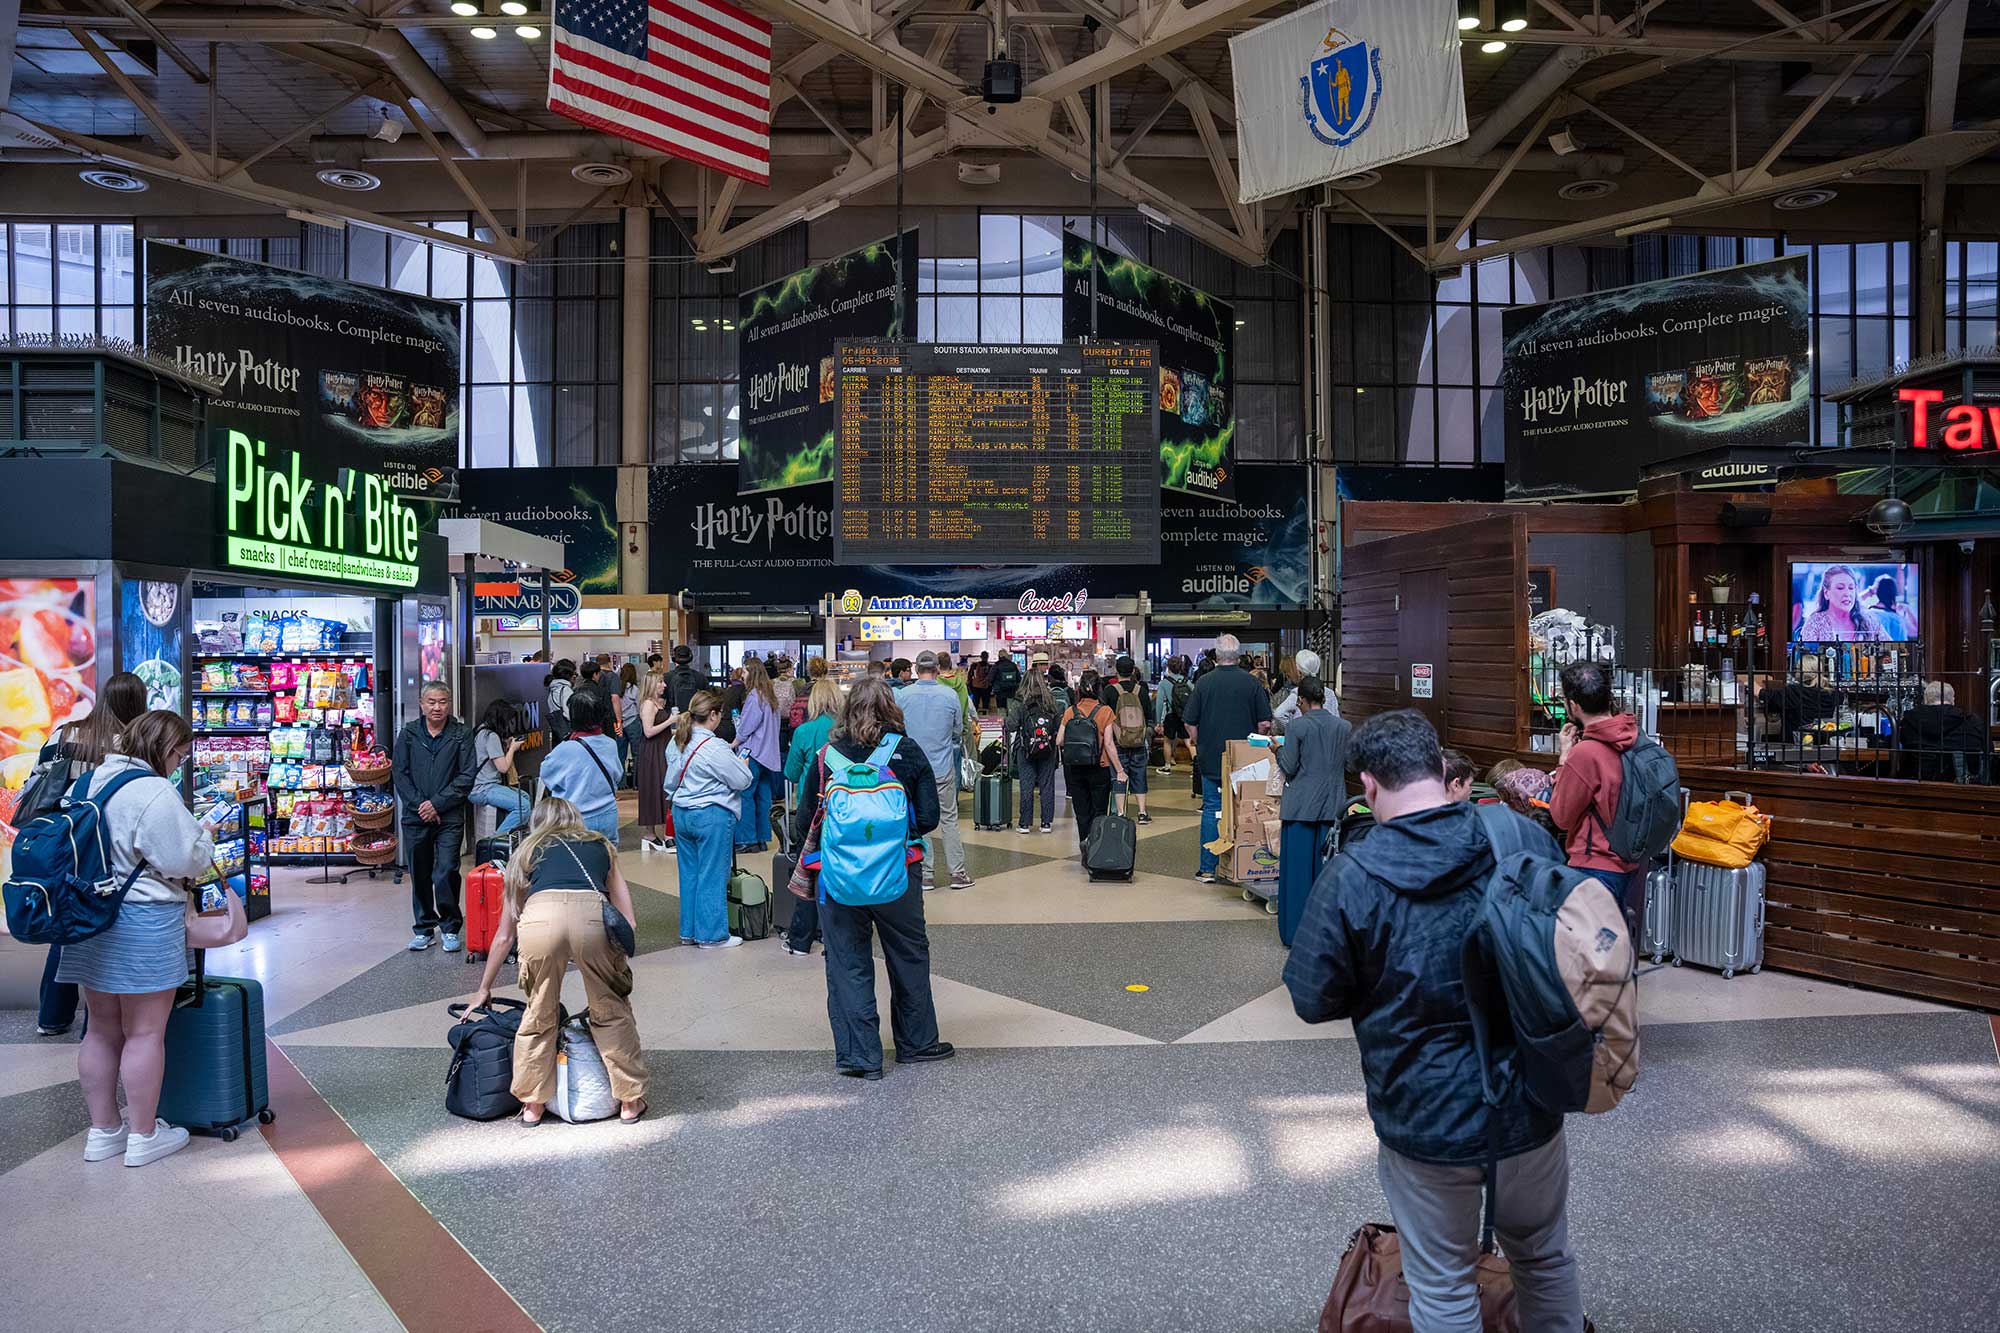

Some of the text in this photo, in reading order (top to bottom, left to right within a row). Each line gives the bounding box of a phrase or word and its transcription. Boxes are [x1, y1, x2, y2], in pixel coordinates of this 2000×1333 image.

[747, 284, 898, 343] All seven audiobooks. Complete mag
[1074, 279, 1089, 297] All
[1096, 291, 1115, 308] even
[1116, 295, 1166, 328] audiobooks.
[1167, 316, 1203, 344] Complete
[168, 288, 446, 355] All seven audiobooks. Complete magic.
[1517, 303, 1788, 357] All seven audiobooks. Complete magic.
[842, 347, 877, 355] Friday
[934, 346, 959, 354] SOUTH
[959, 346, 988, 354] STATION
[1011, 347, 1059, 355] INFORMATION
[1083, 349, 1152, 357] CURRENT TIME
[174, 344, 301, 397] Harry Potter
[1106, 359, 1152, 367] 10:44 AM
[1695, 361, 1737, 379] Harry Potter
[367, 374, 385, 388] Harry
[747, 361, 810, 410] Harry Potter
[207, 397, 301, 417] L-CAST AUDIO EDITIONS
[1520, 376, 1628, 421] Harry Potter
[1522, 418, 1629, 437] THE FULL-CAST AUDIO EDITIONS
[384, 461, 405, 470] LISTEN
[1187, 470, 1218, 490] audible
[228, 429, 419, 562] Pick n' Bite
[464, 511, 501, 522] seven
[505, 506, 592, 521] audiobooks.
[1199, 504, 1286, 519] audiobooks.
[690, 502, 764, 550] Harry
[1160, 527, 1268, 547] omplete magic.
[240, 544, 413, 582] snacks chef created sandwiches & salads
[693, 558, 836, 568] THE FULL-CAST AUDIO EDITION
[1196, 564, 1235, 572] LISTEN ON
[1182, 575, 1250, 593] audible
[475, 594, 571, 610] INNABN
[1018, 589, 1073, 614] Carvel
[253, 610, 308, 622] SNACKS
